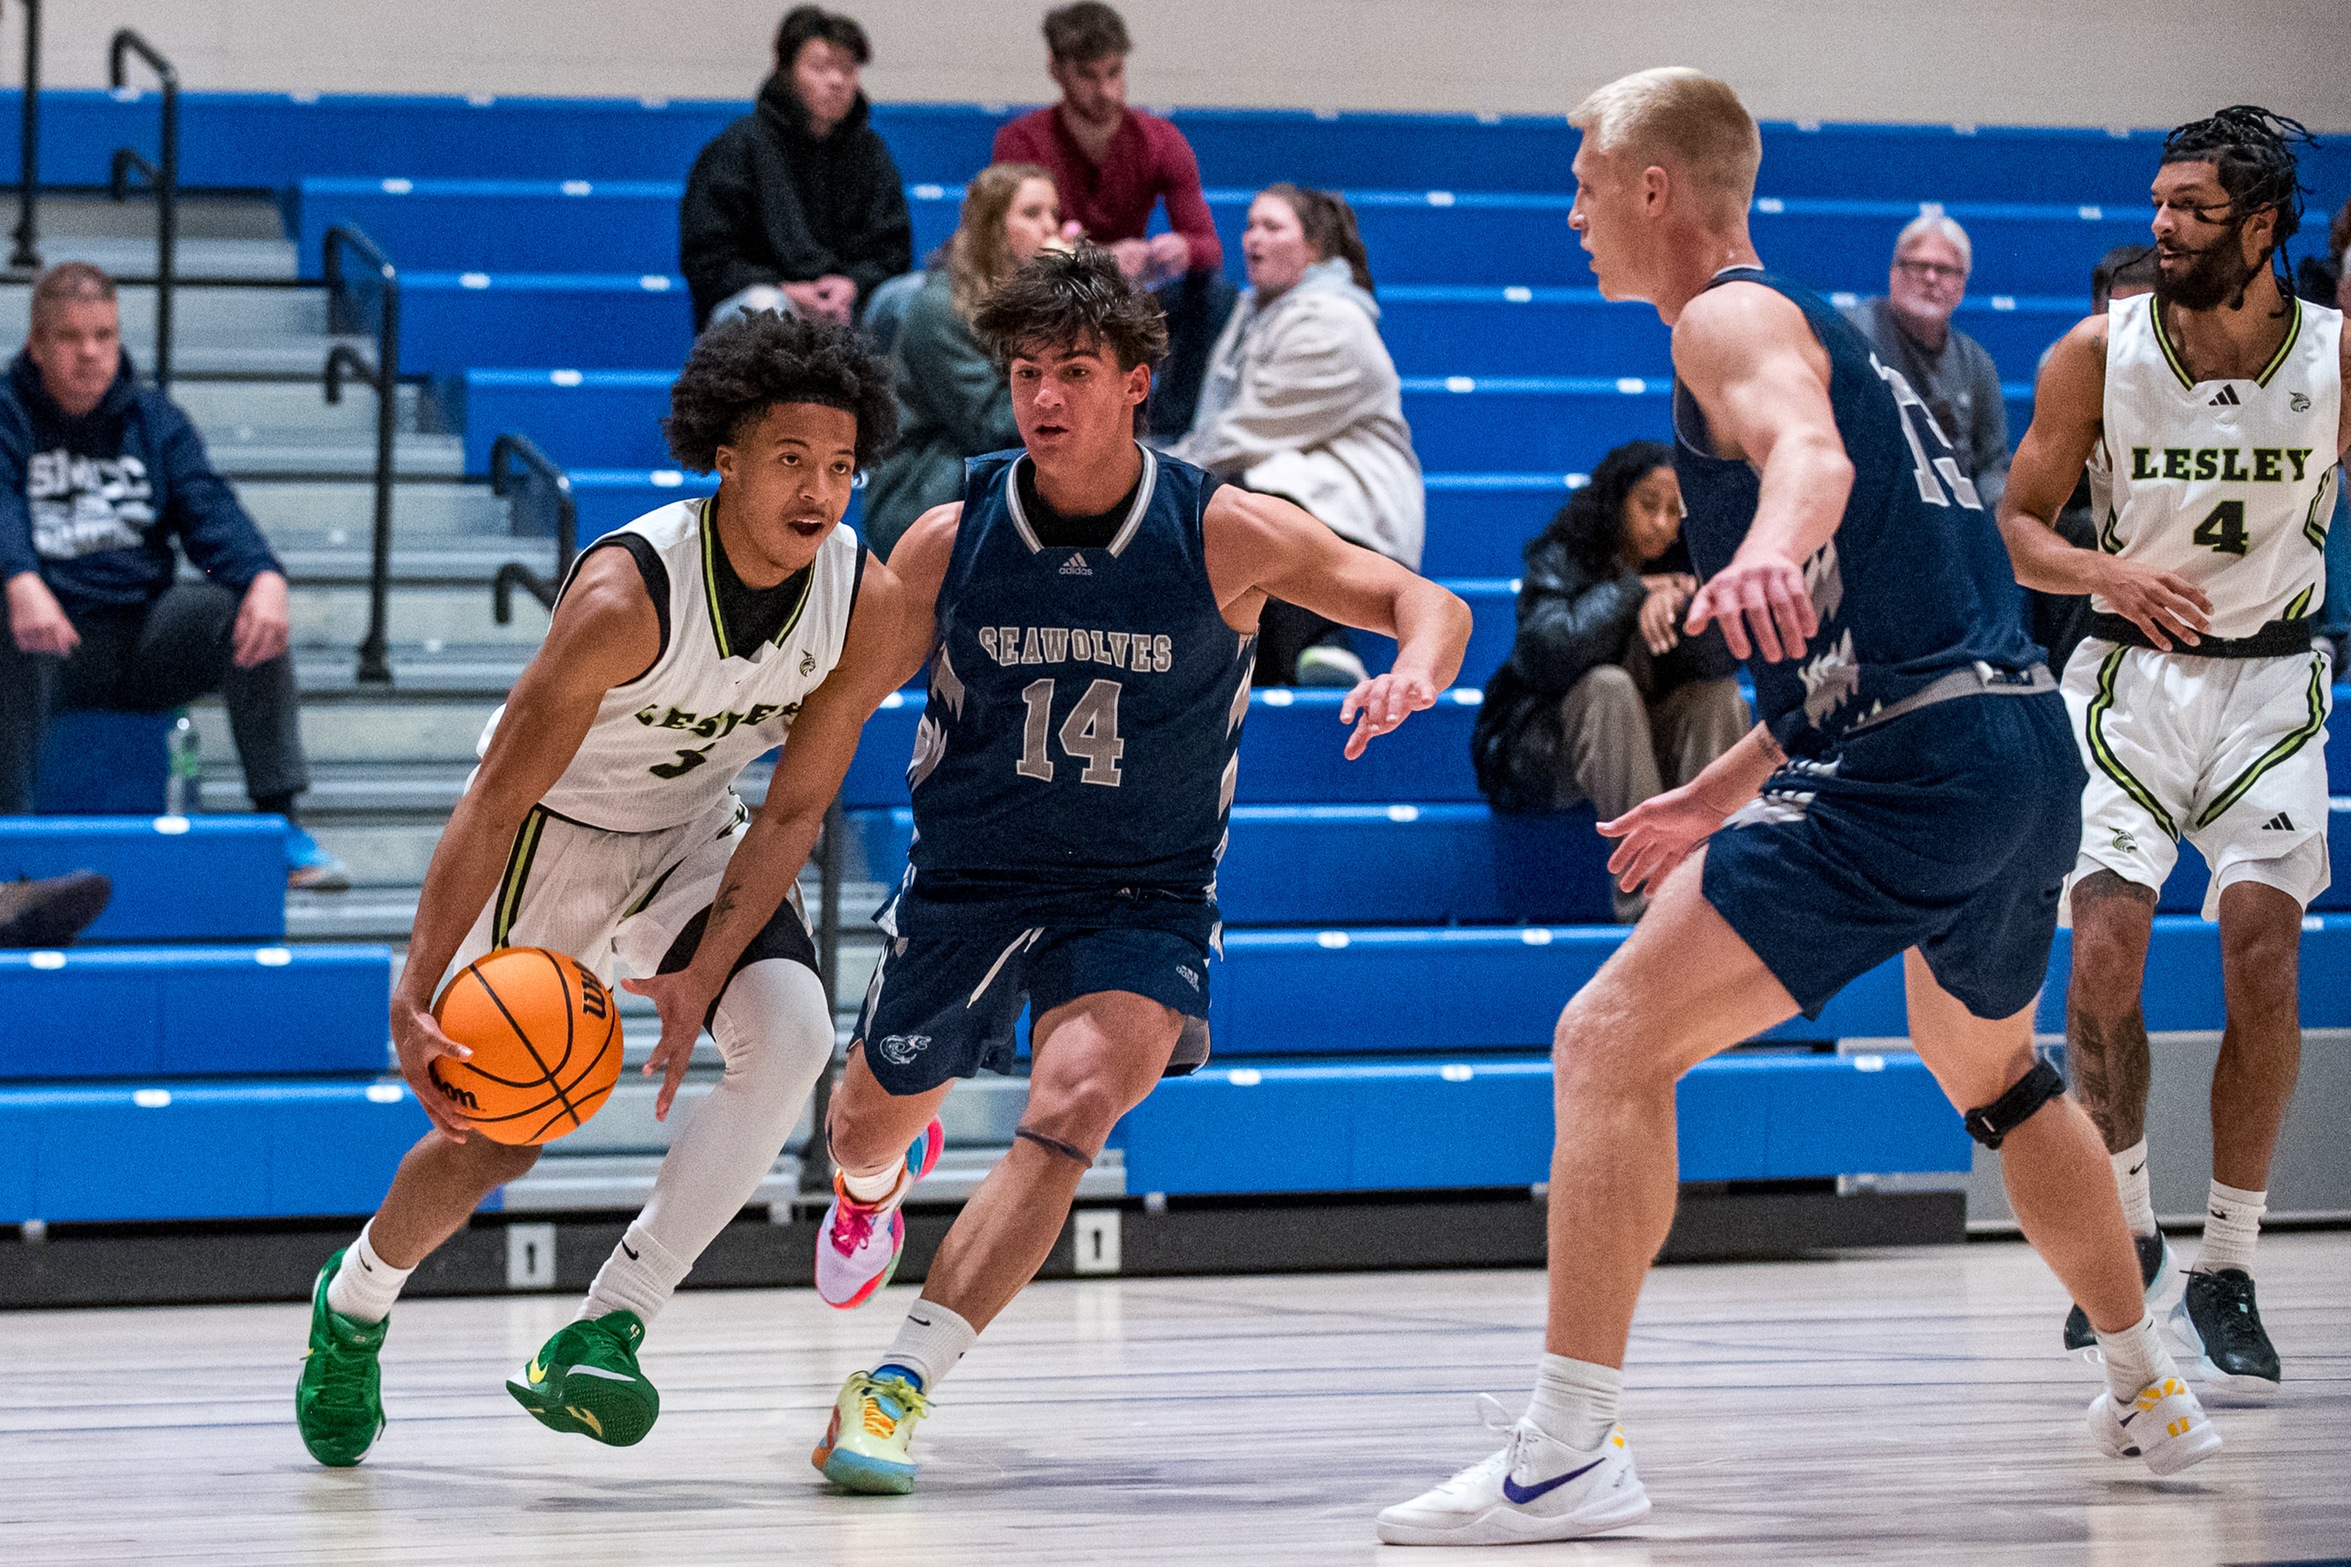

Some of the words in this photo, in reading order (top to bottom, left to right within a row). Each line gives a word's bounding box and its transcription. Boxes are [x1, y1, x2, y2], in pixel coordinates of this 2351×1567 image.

[2131, 446, 2314, 483] LESLEY
[2193, 500, 2249, 557] 4
[1058, 565, 1093, 576] adidas
[979, 626, 1173, 673] SEAWOLVES
[1016, 678, 1125, 788] 14
